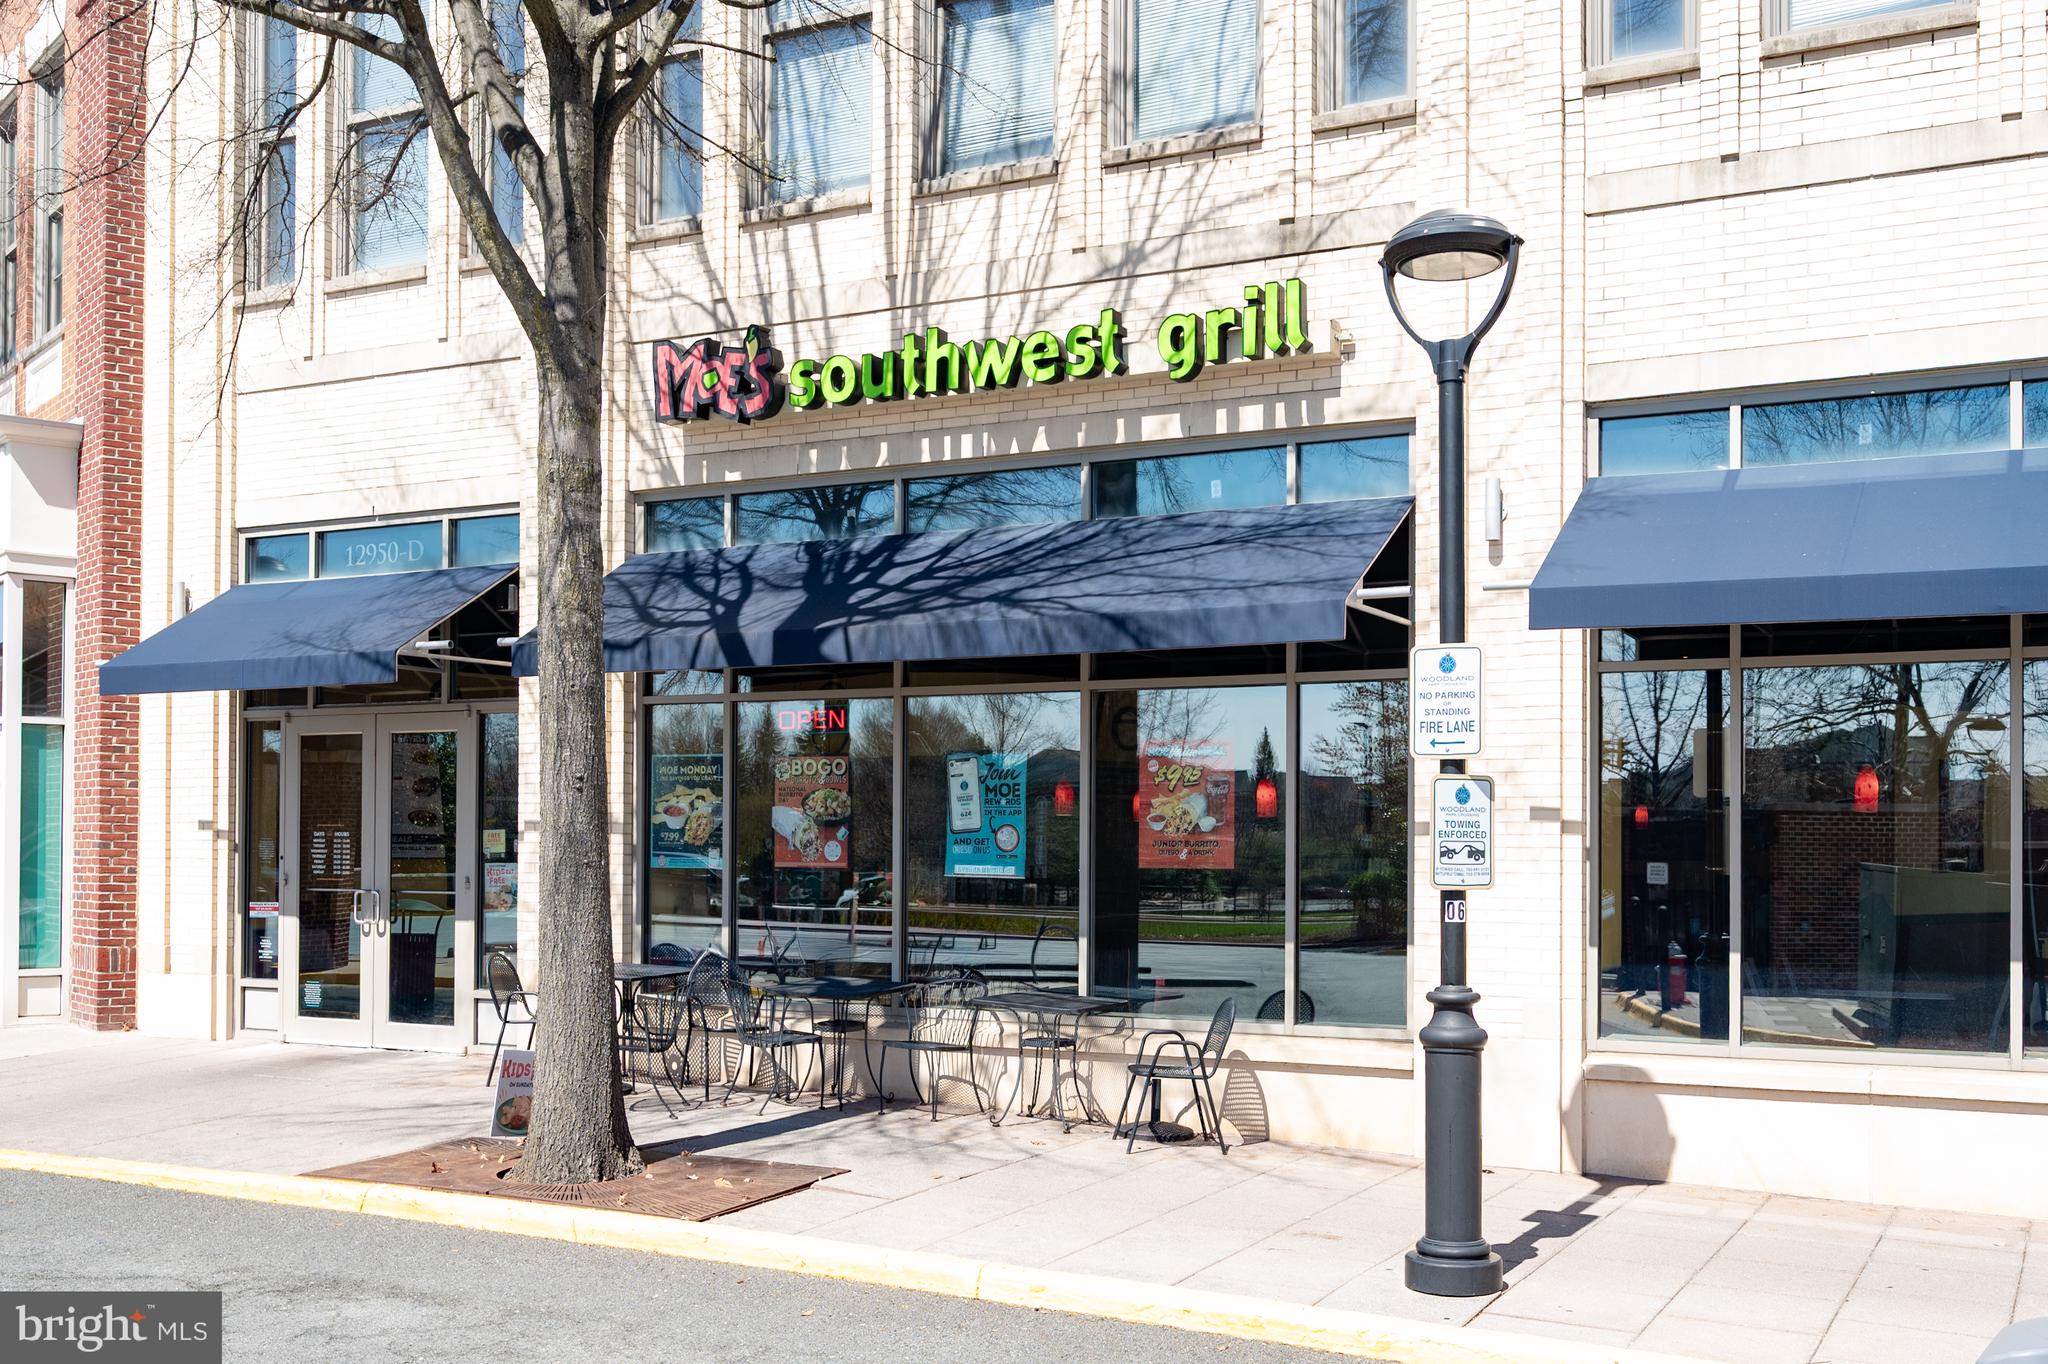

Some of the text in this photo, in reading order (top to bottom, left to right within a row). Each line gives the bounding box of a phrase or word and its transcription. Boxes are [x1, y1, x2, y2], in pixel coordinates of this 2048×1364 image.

[789, 308, 1128, 409] southwest
[1158, 278, 1310, 382] grill
[346, 539, 424, 566] 12950-D
[1419, 690, 1476, 700] NO PARKING
[1424, 707, 1471, 717] STANDING
[778, 709, 846, 731] OPEN
[1419, 720, 1475, 734] FIRE LANE
[680, 765, 718, 775] MONDAY
[791, 758, 847, 776] BOGO
[984, 783, 1021, 798] MOE
[1008, 809, 1022, 817] APP
[1444, 820, 1481, 829] TOWING
[1438, 830, 1487, 839] ENFORCED
[953, 837, 990, 846] AND GET
[1152, 839, 1182, 848] JUNIOR
[489, 877, 505, 885] FREE
[1446, 901, 1465, 921] 06
[502, 1059, 531, 1078] KIDS
